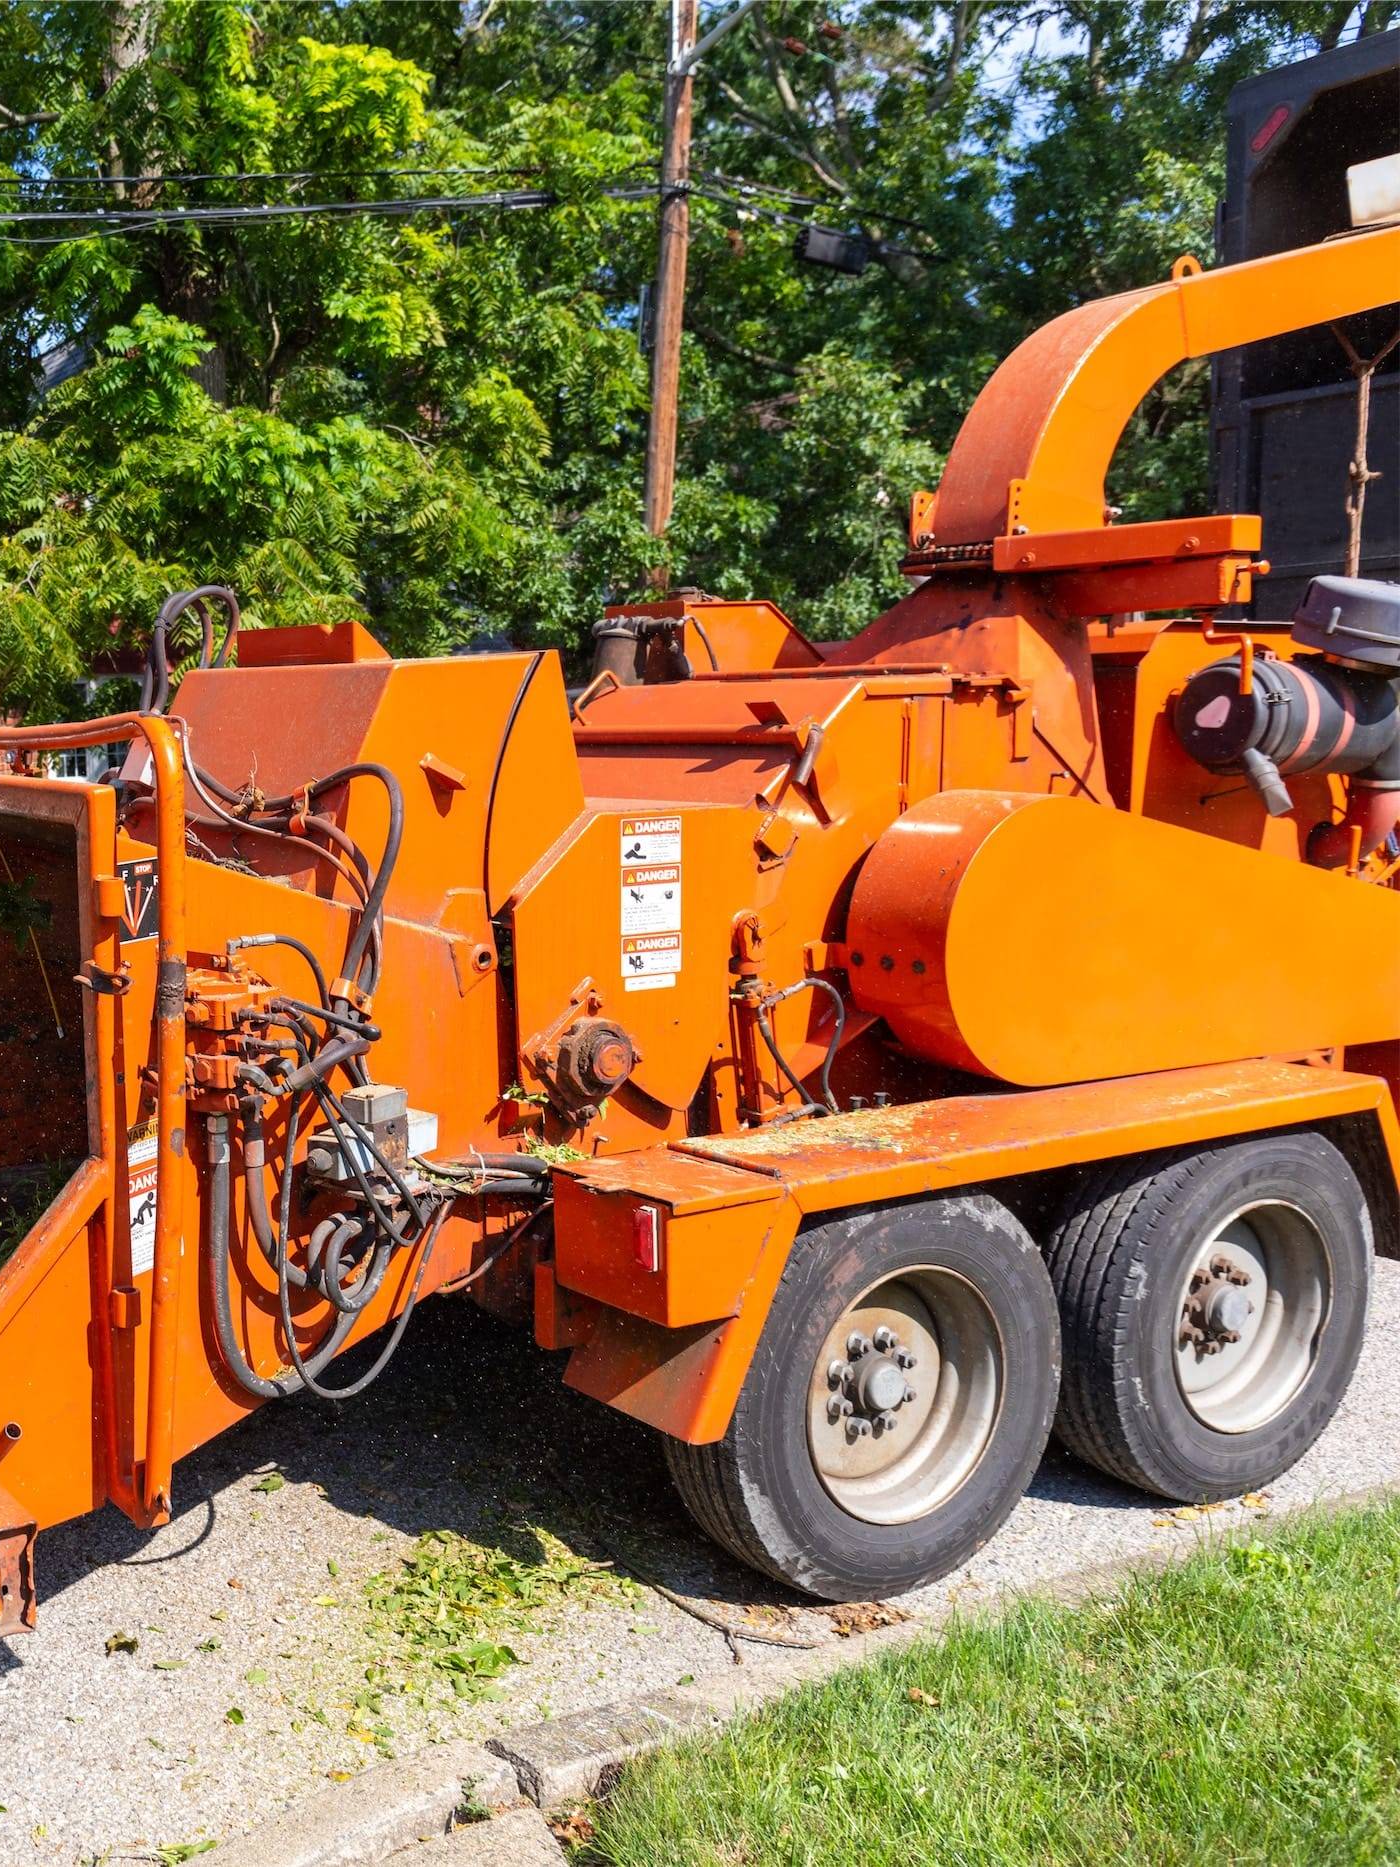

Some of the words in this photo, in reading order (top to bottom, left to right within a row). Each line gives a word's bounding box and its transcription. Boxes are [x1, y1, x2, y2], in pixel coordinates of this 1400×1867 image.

[635, 820, 680, 833] DANGER
[122, 870, 129, 881] F
[135, 864, 152, 874] STOP
[637, 868, 678, 883] DANGER
[636, 937, 678, 951] DANGER
